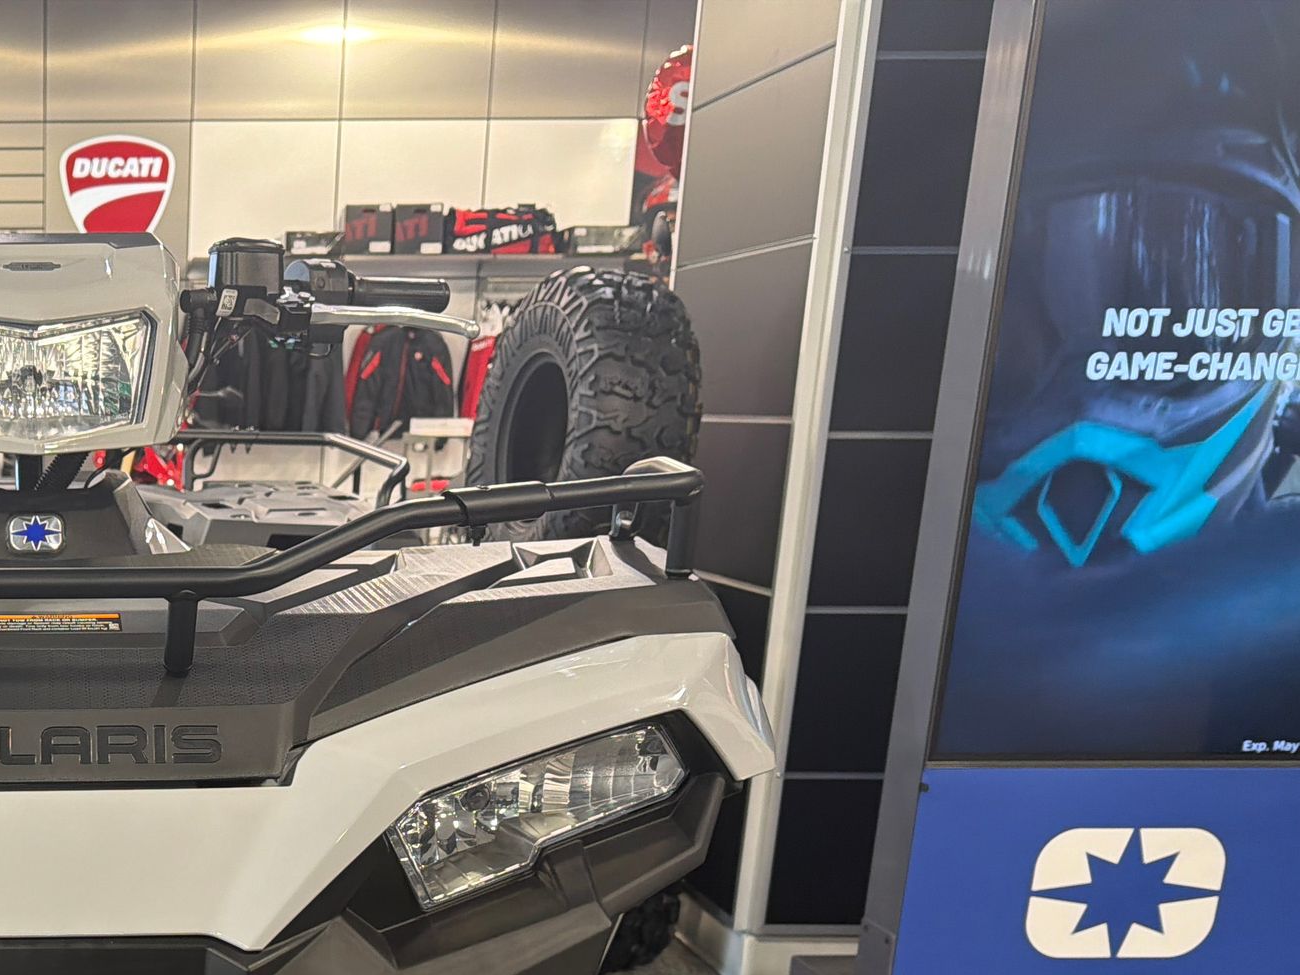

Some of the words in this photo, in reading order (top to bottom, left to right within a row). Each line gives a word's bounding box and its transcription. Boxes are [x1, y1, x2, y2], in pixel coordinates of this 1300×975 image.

[71, 156, 164, 179] DUCATI
[1102, 307, 1171, 337] NOT
[1172, 307, 1259, 337] JUST
[1262, 308, 1300, 338] GE
[1086, 351, 1300, 381] GAME-CHANG
[1241, 739, 1270, 754] Exp.
[1271, 739, 1300, 754] May
